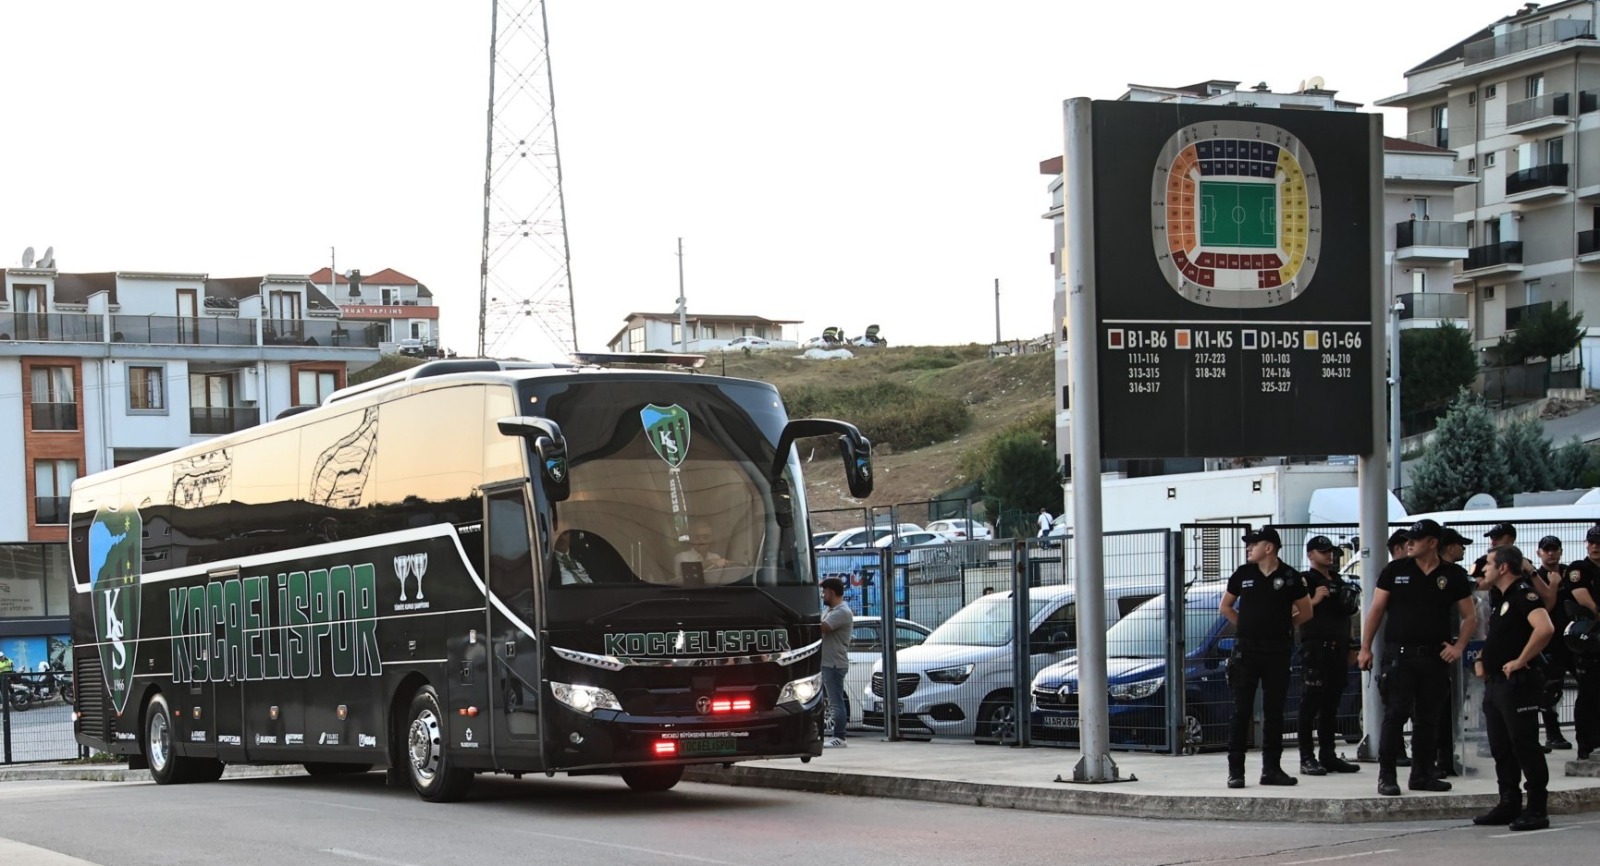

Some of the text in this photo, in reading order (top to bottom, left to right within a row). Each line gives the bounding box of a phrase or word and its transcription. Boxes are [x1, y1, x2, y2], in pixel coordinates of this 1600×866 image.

[1128, 331, 1167, 348] B1-B6
[1195, 331, 1233, 348] K1-K5
[1261, 332, 1299, 348] D1-D5
[1322, 332, 1362, 349] G1-G6
[1128, 354, 1160, 364] 111-116
[1195, 354, 1226, 364] 217-223
[1262, 354, 1290, 364] 101-103
[1322, 354, 1351, 364] 204-210
[1128, 368, 1160, 378] 313-315
[1195, 368, 1226, 378] 318-324
[1262, 368, 1290, 378] 124-126
[1322, 368, 1351, 378] 304-312
[1128, 382, 1160, 392] 316-317
[1262, 382, 1290, 392] 325-327
[659, 430, 678, 454] KS
[104, 588, 126, 670] KS
[114, 678, 125, 691] 1966
